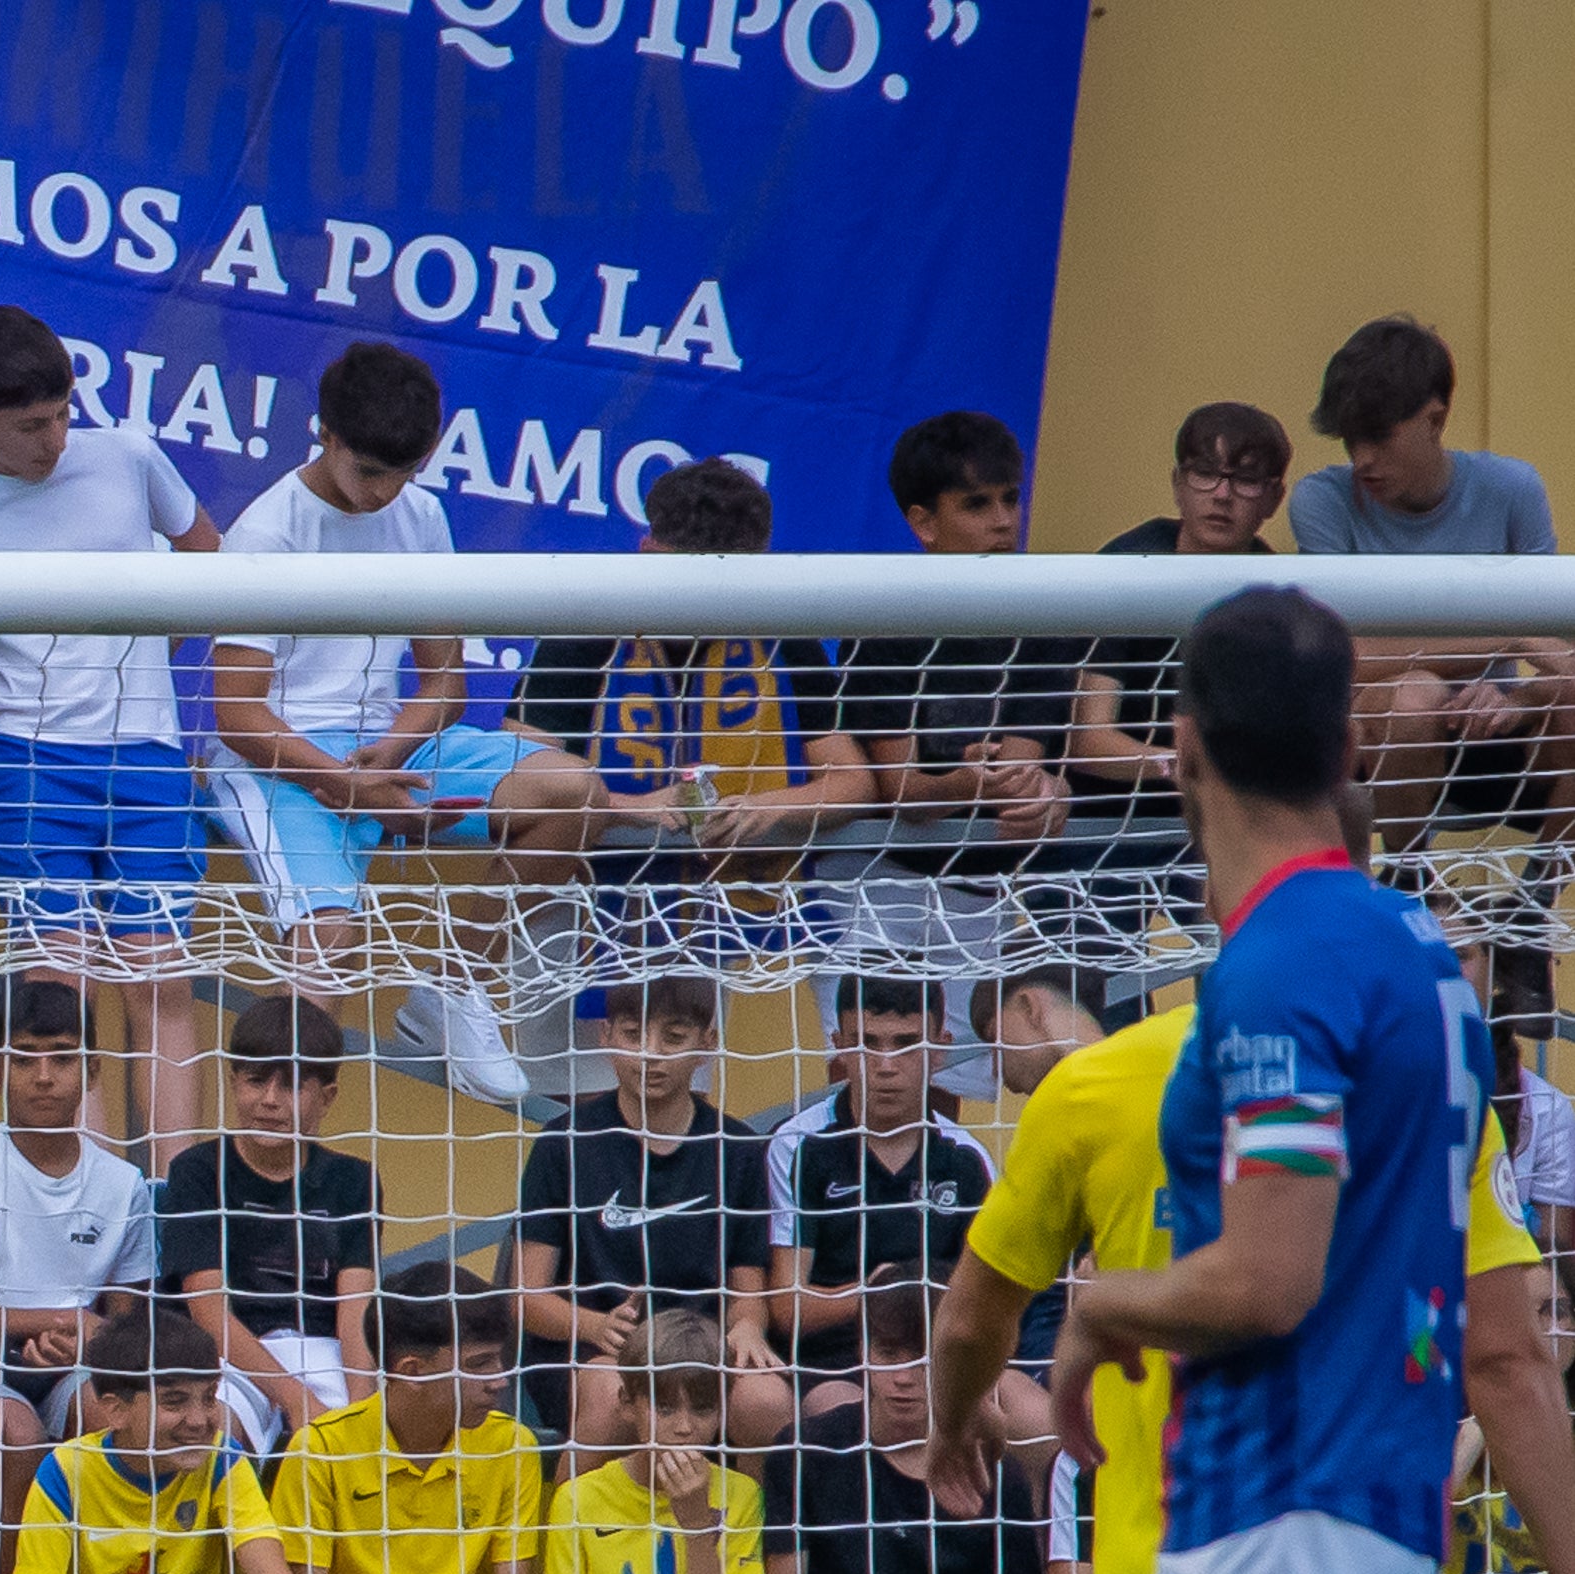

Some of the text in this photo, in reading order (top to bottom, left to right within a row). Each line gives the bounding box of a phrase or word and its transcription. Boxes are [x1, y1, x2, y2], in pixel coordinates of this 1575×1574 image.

[201, 205, 289, 296] A
[315, 219, 559, 342] POR
[588, 263, 743, 372] LA
